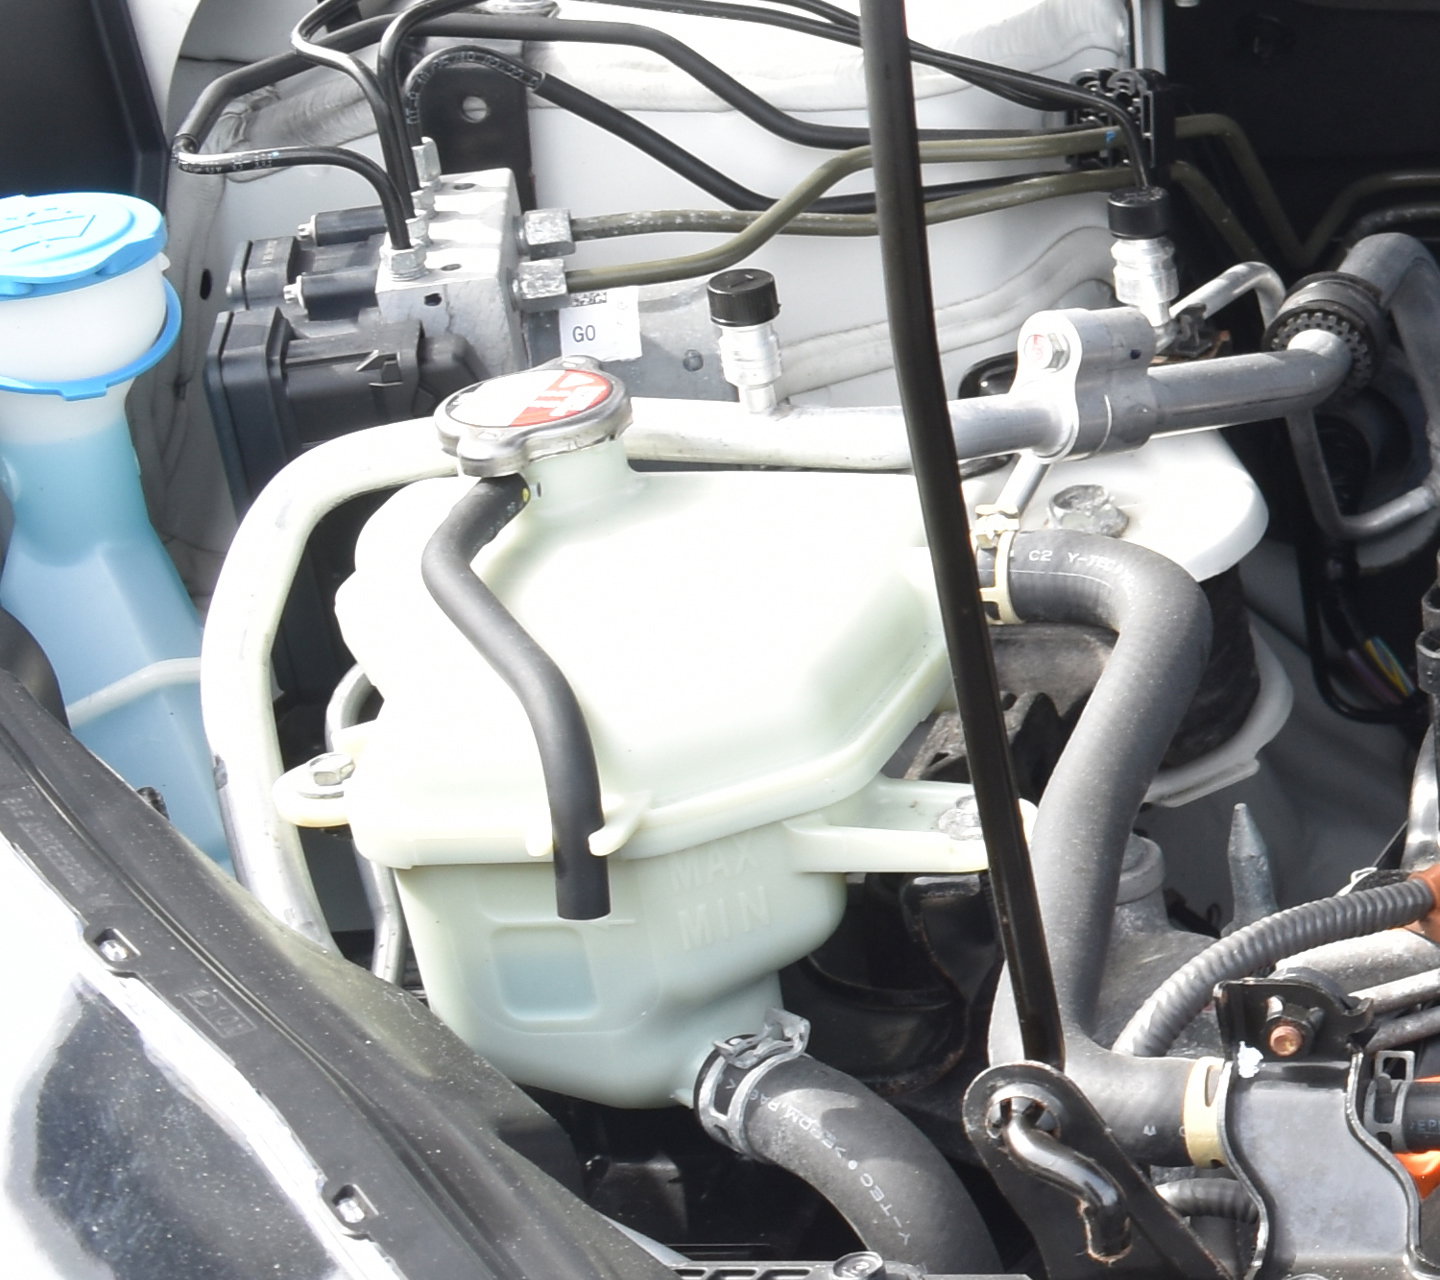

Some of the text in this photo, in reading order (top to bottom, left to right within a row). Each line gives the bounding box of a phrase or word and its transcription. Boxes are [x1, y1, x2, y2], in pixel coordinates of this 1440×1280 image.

[1028, 549, 1053, 562] C2
[670, 836, 759, 891] MAX
[677, 885, 770, 951] MIN
[859, 1172, 911, 1246] Y-TEC
